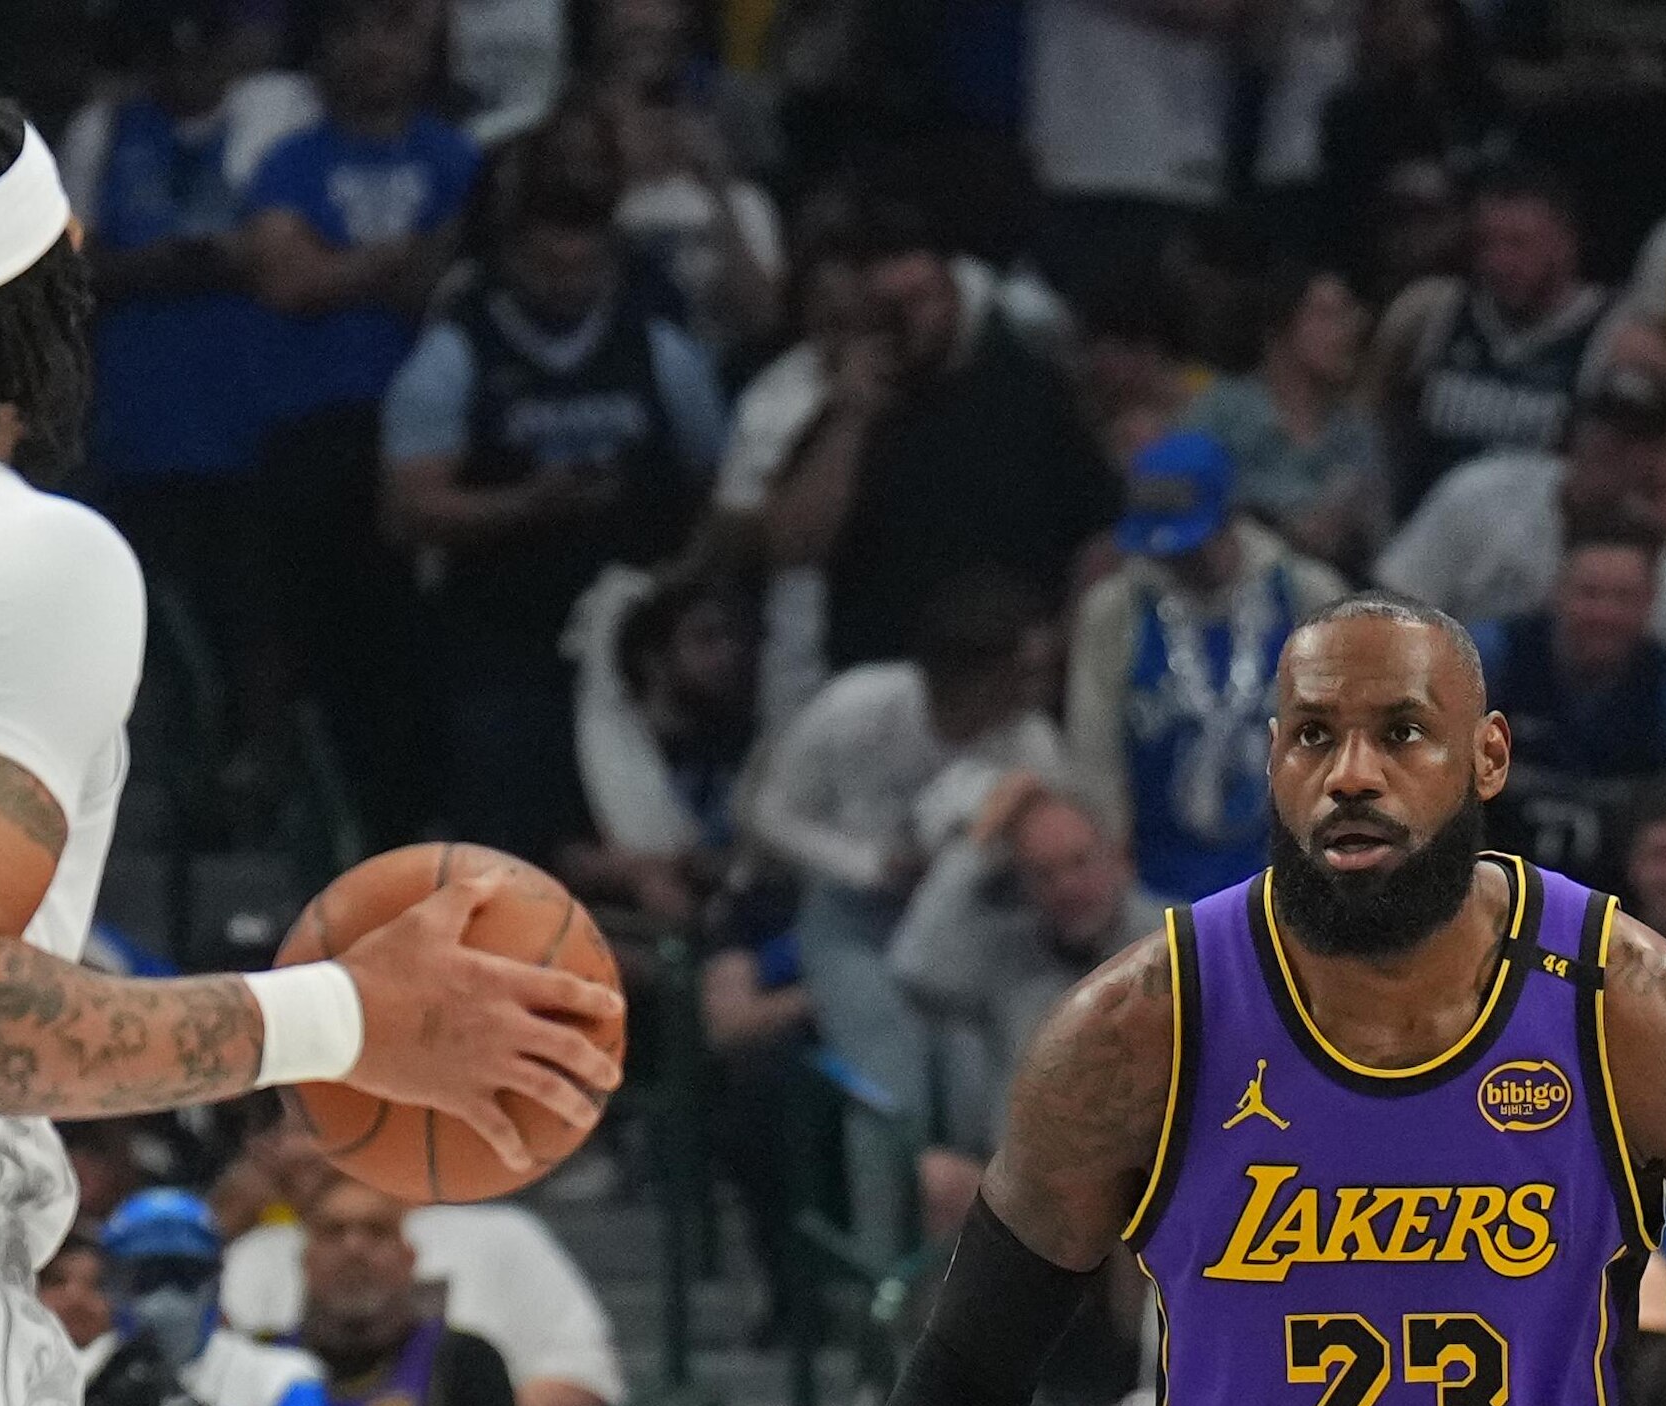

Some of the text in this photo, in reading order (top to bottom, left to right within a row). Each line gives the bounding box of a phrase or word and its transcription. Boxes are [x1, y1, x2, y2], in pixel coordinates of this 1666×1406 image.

[1542, 953, 1569, 978] 44
[1486, 1078, 1565, 1110] bibigo
[1203, 1164, 1558, 1283] LAKERS
